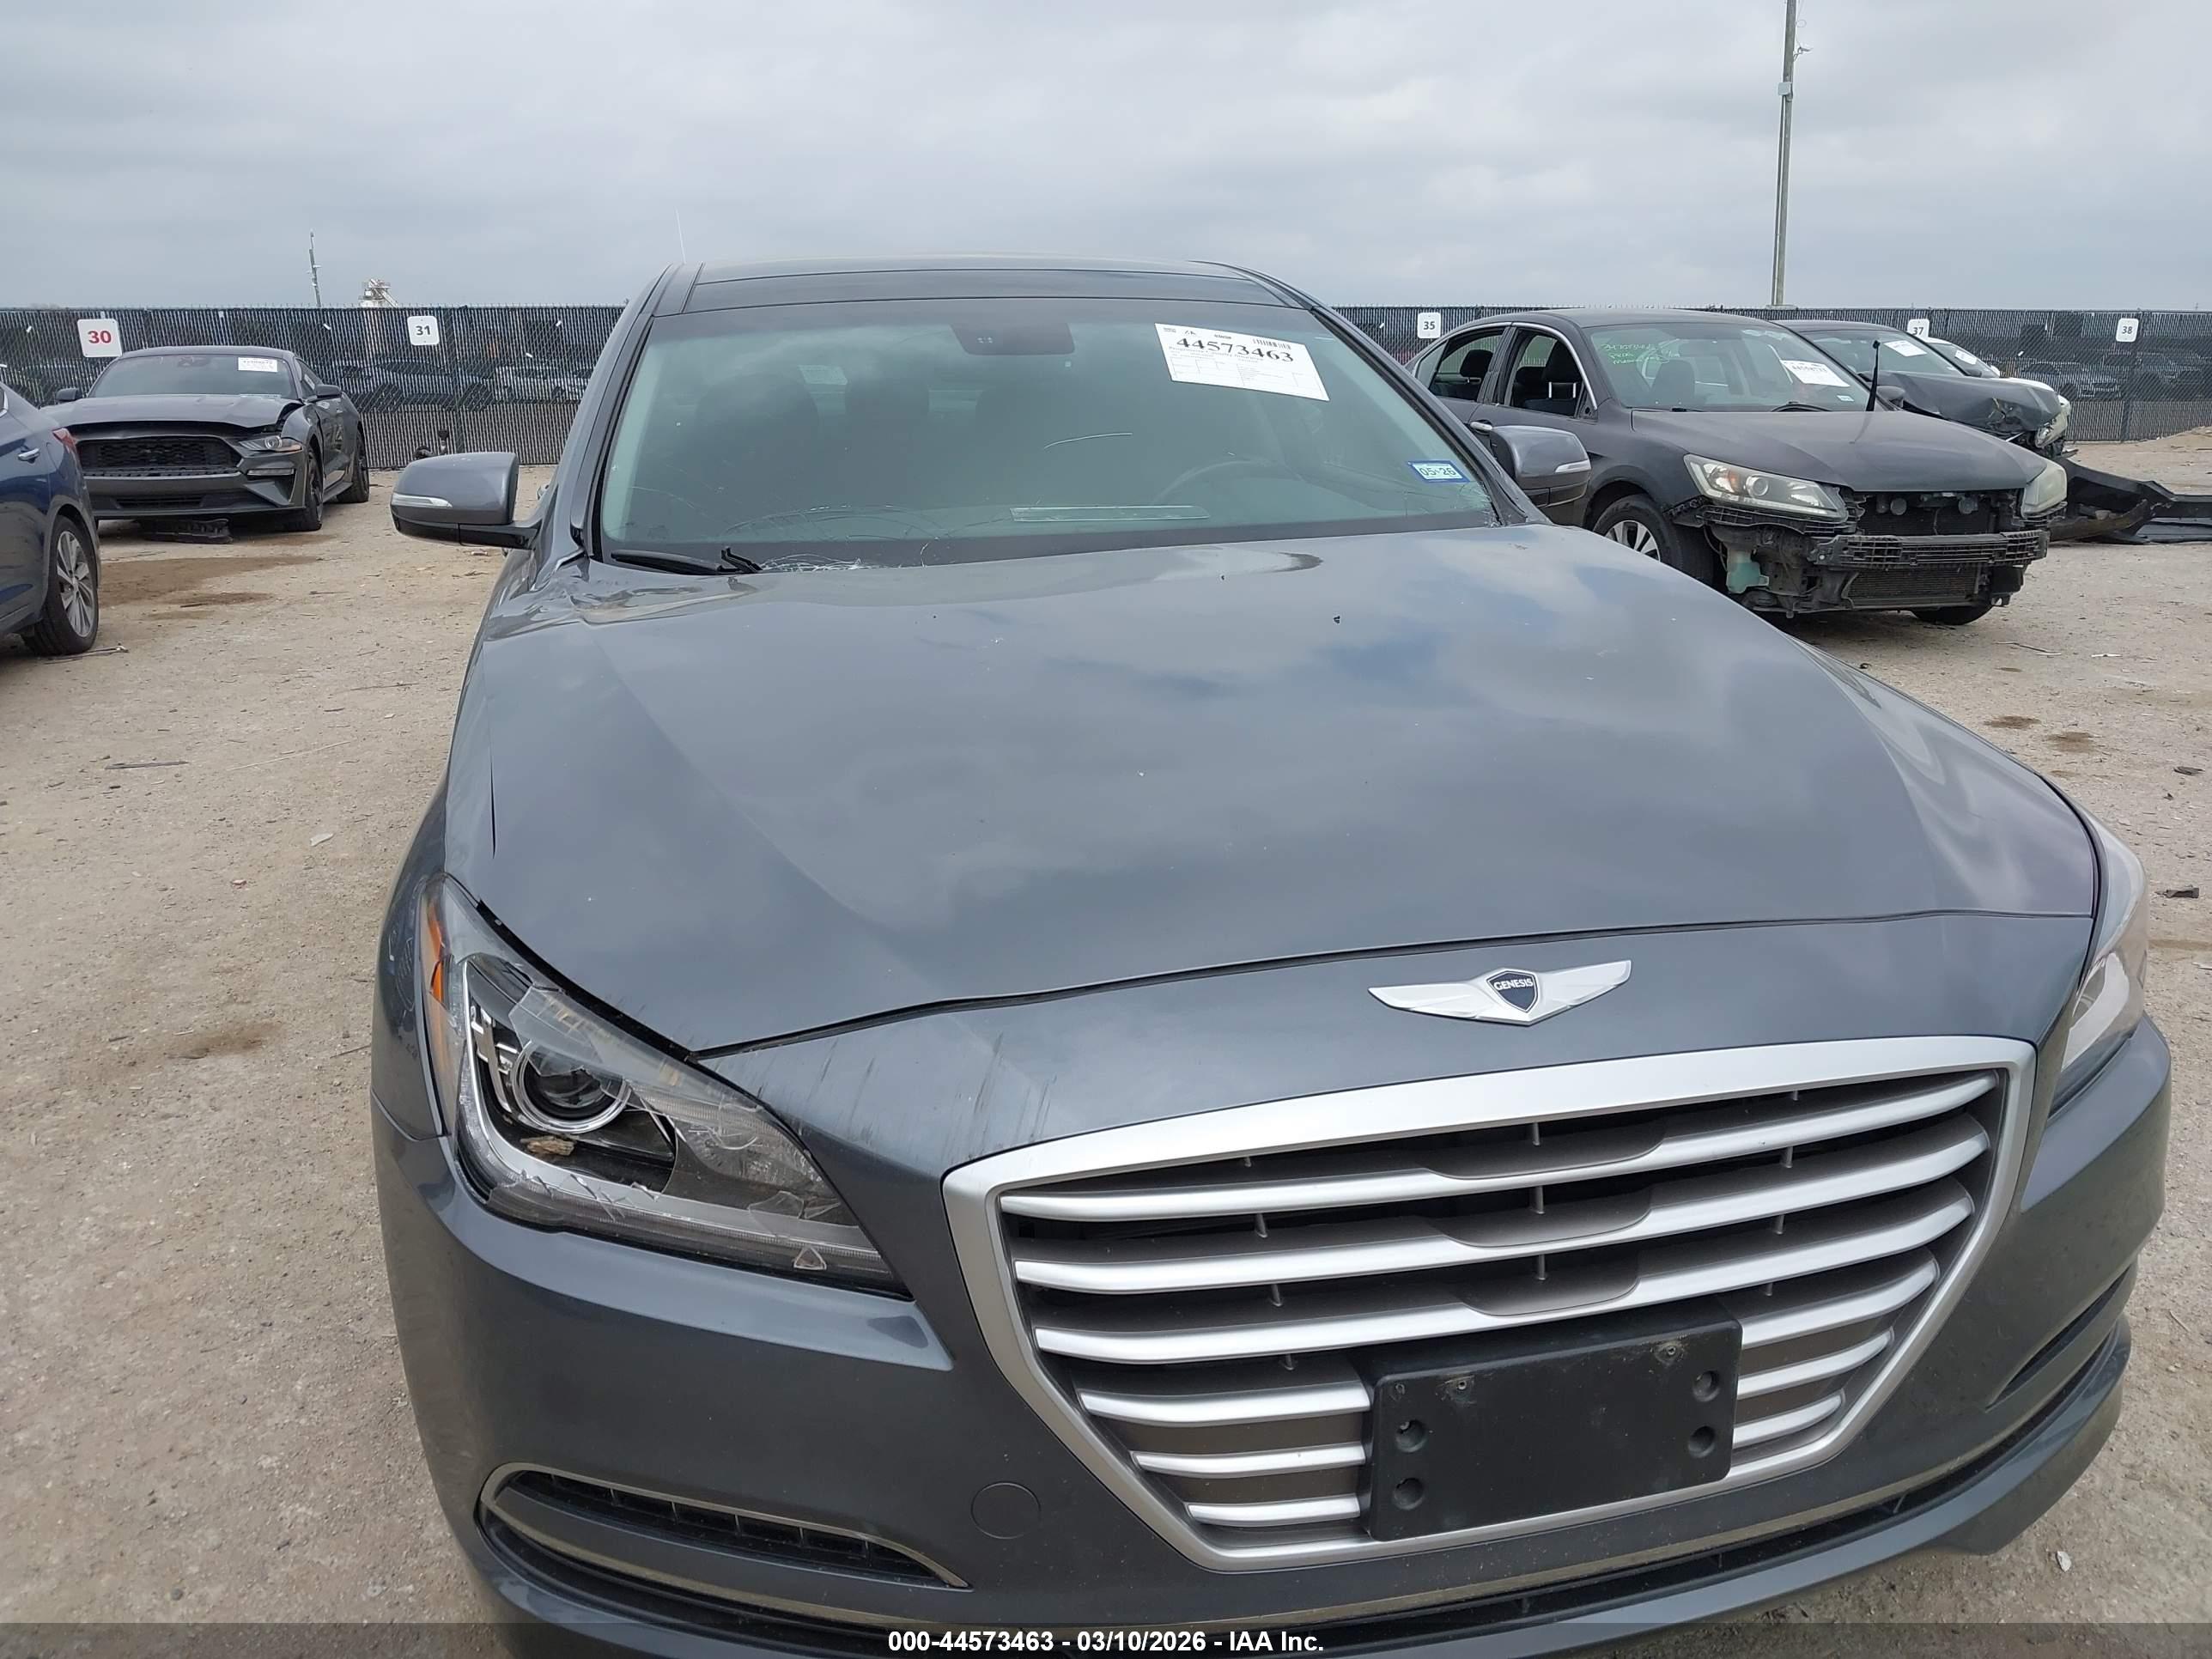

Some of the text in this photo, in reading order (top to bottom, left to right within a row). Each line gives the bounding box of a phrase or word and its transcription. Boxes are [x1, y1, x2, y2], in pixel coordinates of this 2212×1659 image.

[415, 325, 431, 336] 31
[1423, 320, 1436, 331] 35
[1911, 326, 1924, 336] 37
[2122, 325, 2133, 335] 38
[88, 330, 112, 344] 30
[1176, 337, 1294, 362] 44573463
[1419, 467, 1457, 476] 05 26
[1493, 977, 1534, 991] GENESIS
